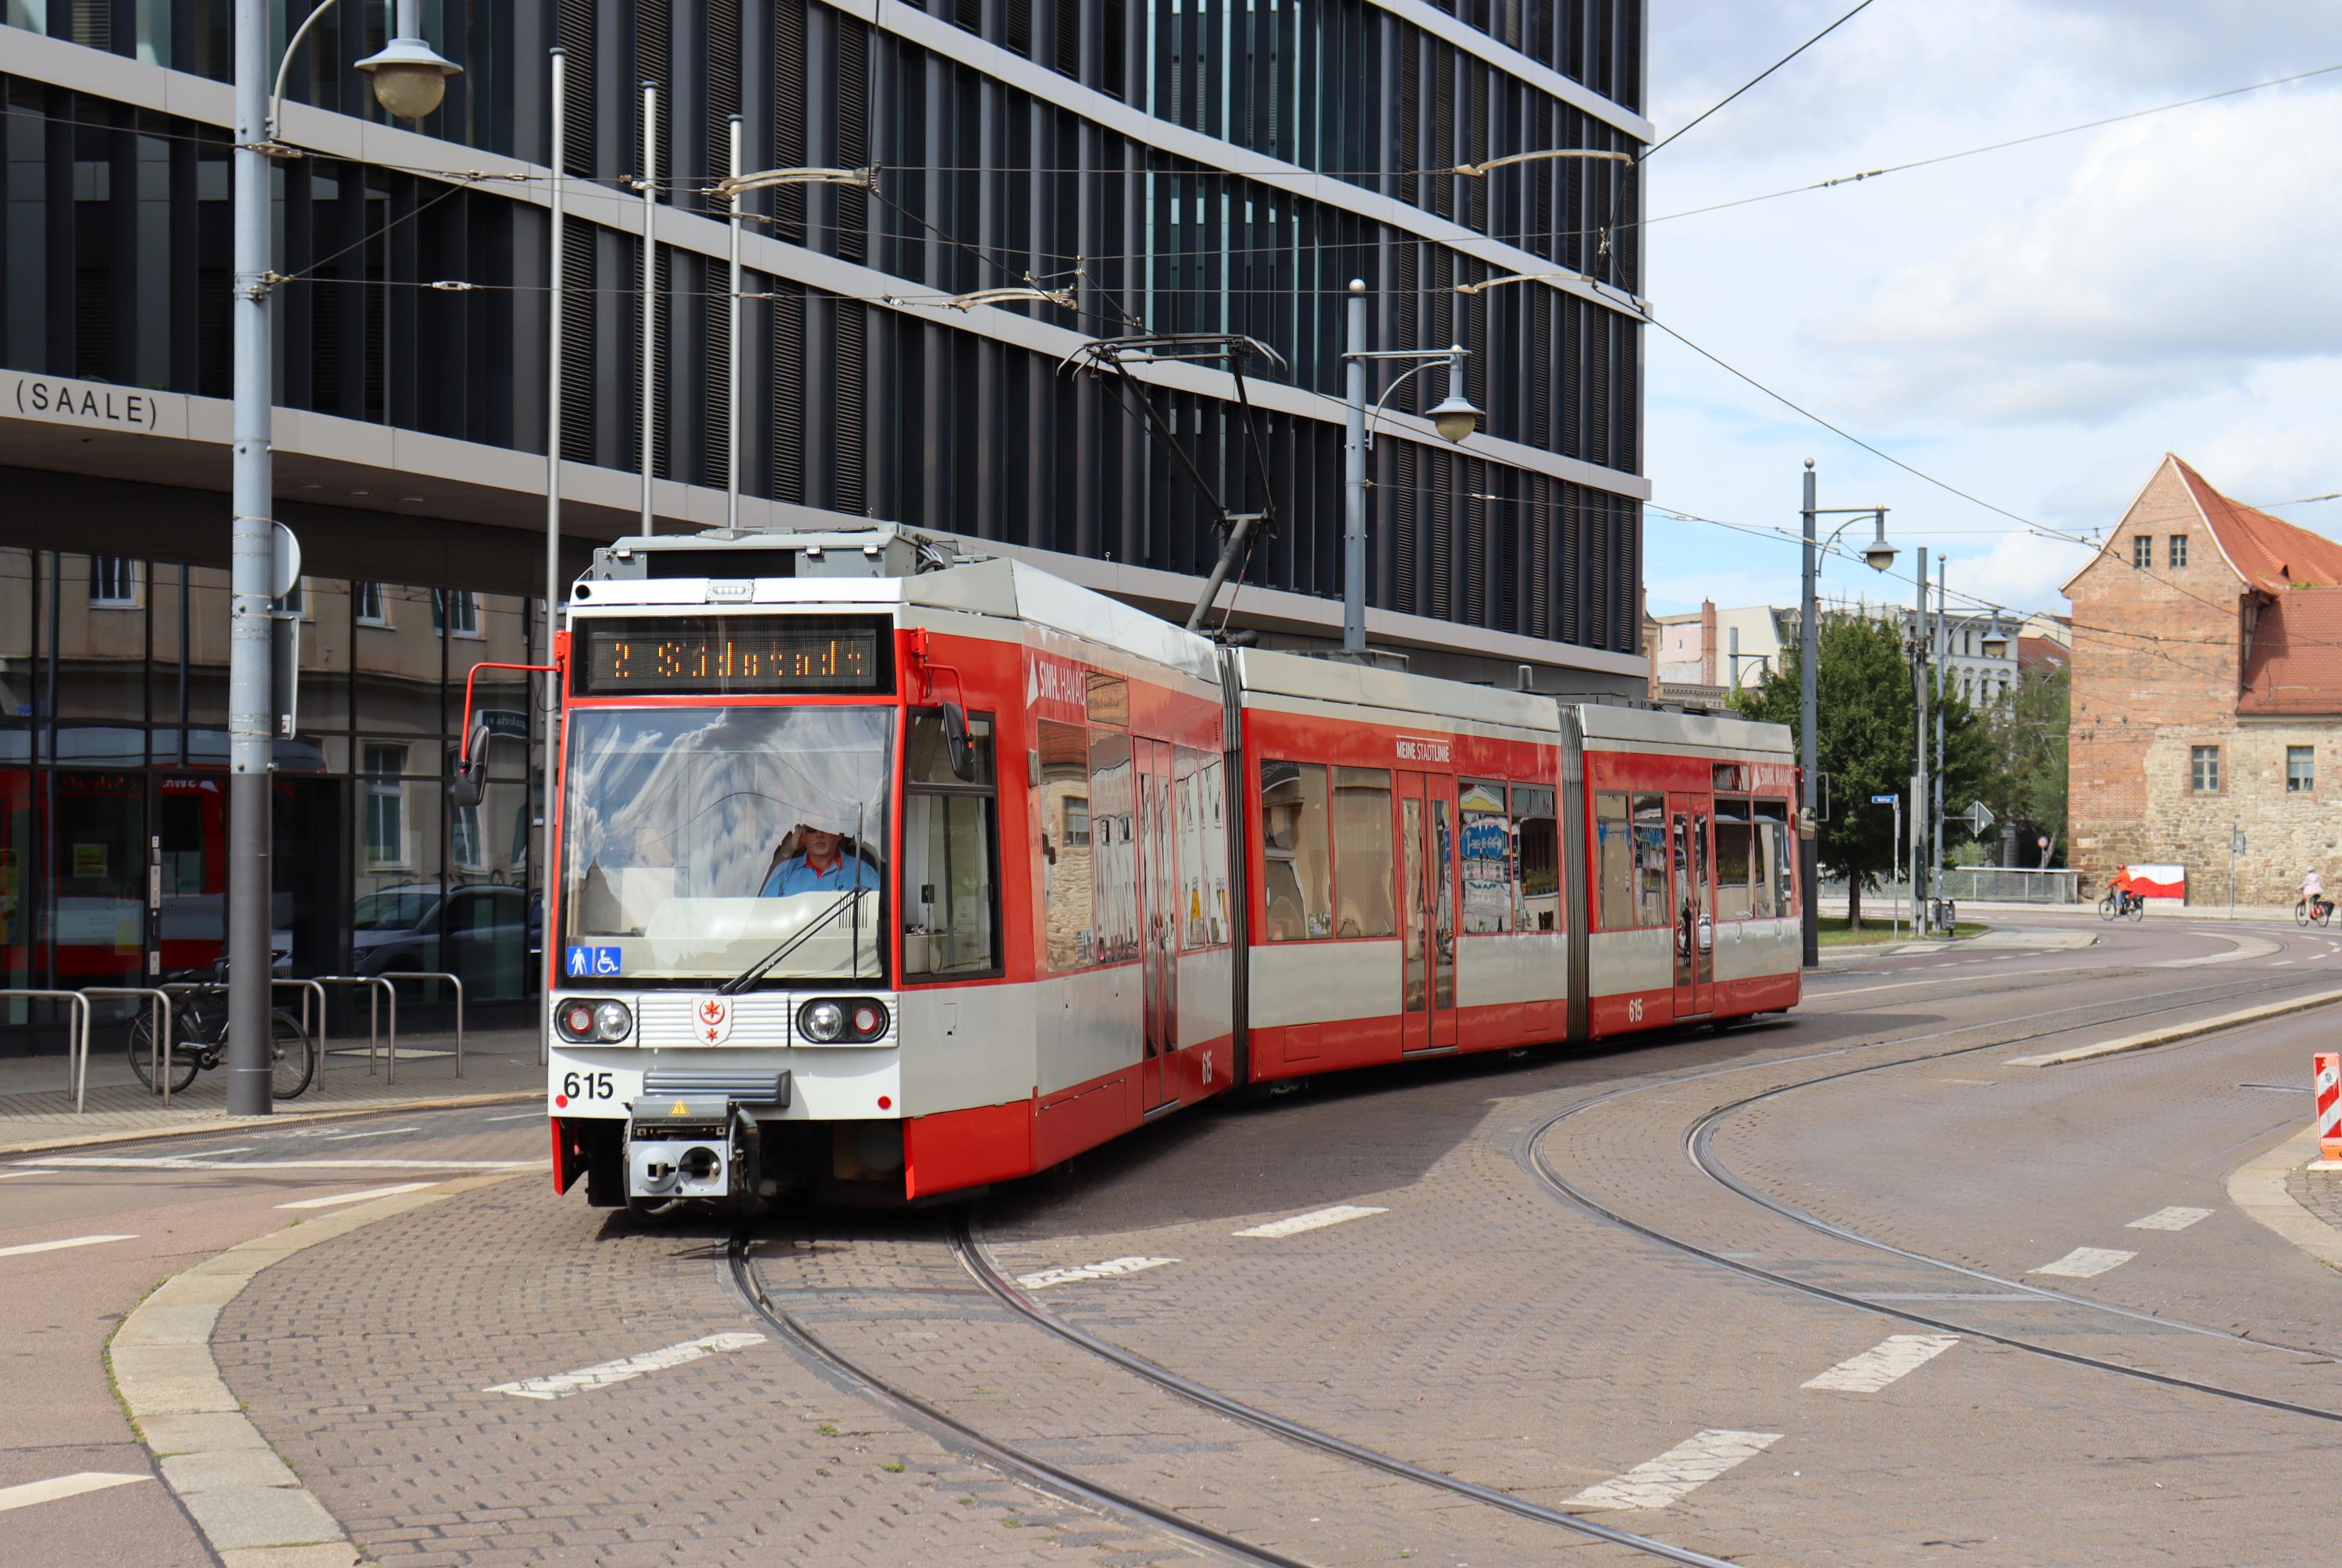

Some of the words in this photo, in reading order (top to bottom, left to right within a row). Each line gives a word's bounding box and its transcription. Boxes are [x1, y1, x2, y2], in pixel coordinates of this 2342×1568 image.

[17, 379, 156, 430] (SAALE)
[614, 642, 630, 677] 2
[1396, 740, 1416, 760] MEINE
[1417, 742, 1450, 763] STADTLINIE
[1629, 998, 1643, 1023] 615
[1202, 1050, 1212, 1086] 615
[564, 1072, 614, 1100] 615
